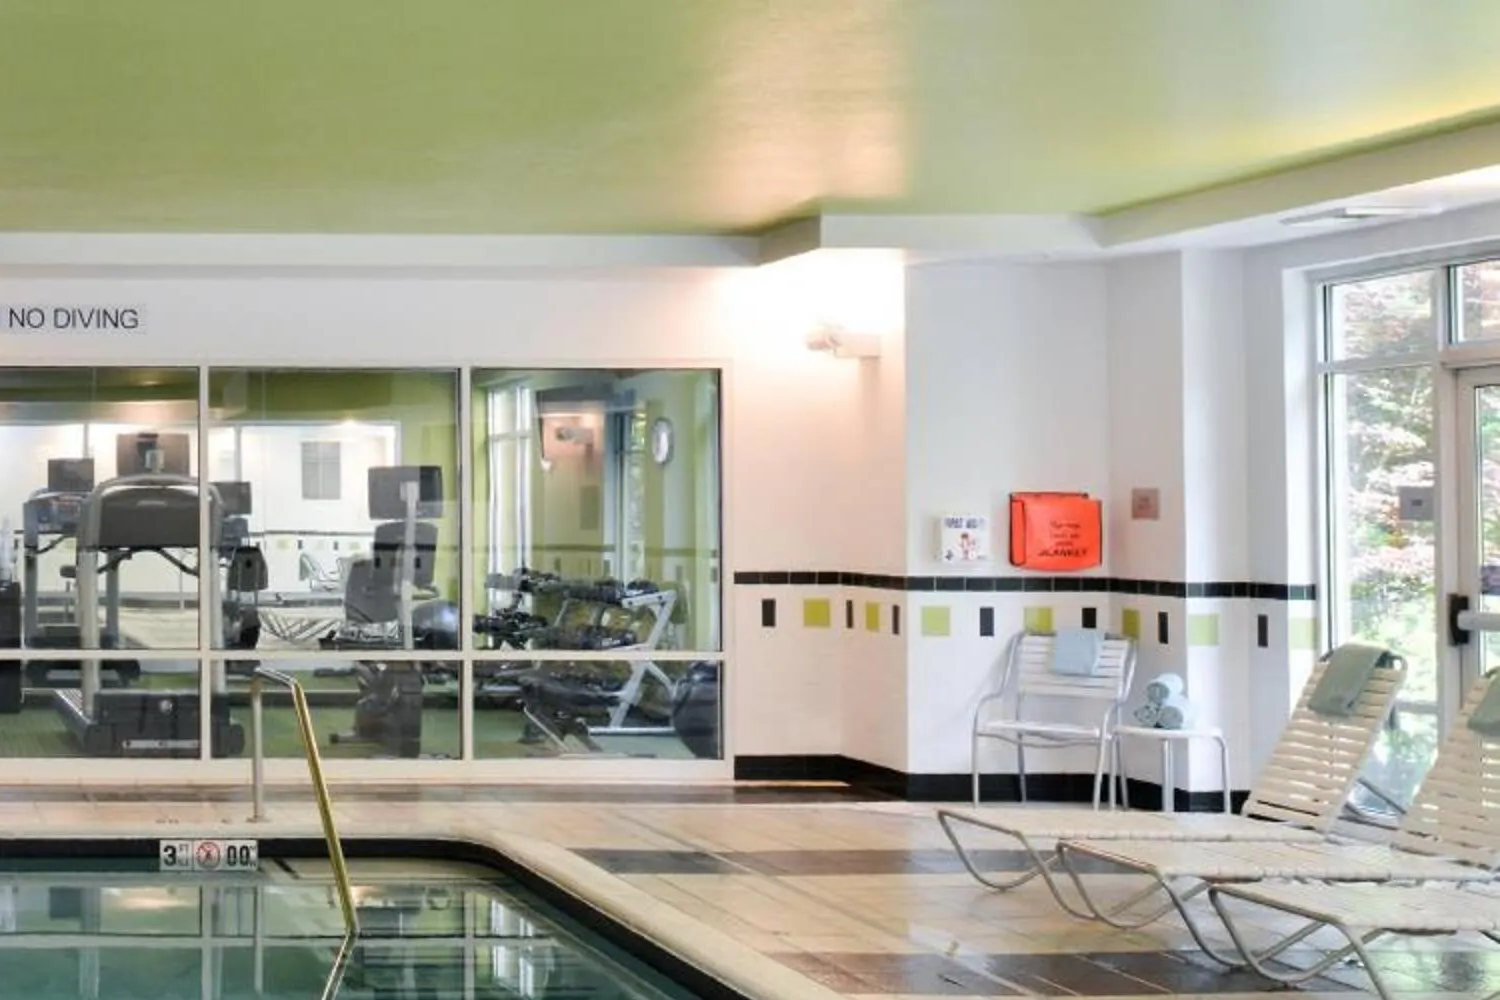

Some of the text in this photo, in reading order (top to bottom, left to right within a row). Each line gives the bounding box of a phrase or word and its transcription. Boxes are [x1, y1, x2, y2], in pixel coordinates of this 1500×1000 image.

[8, 308, 139, 329] NO DIVING
[163, 845, 177, 867] 3
